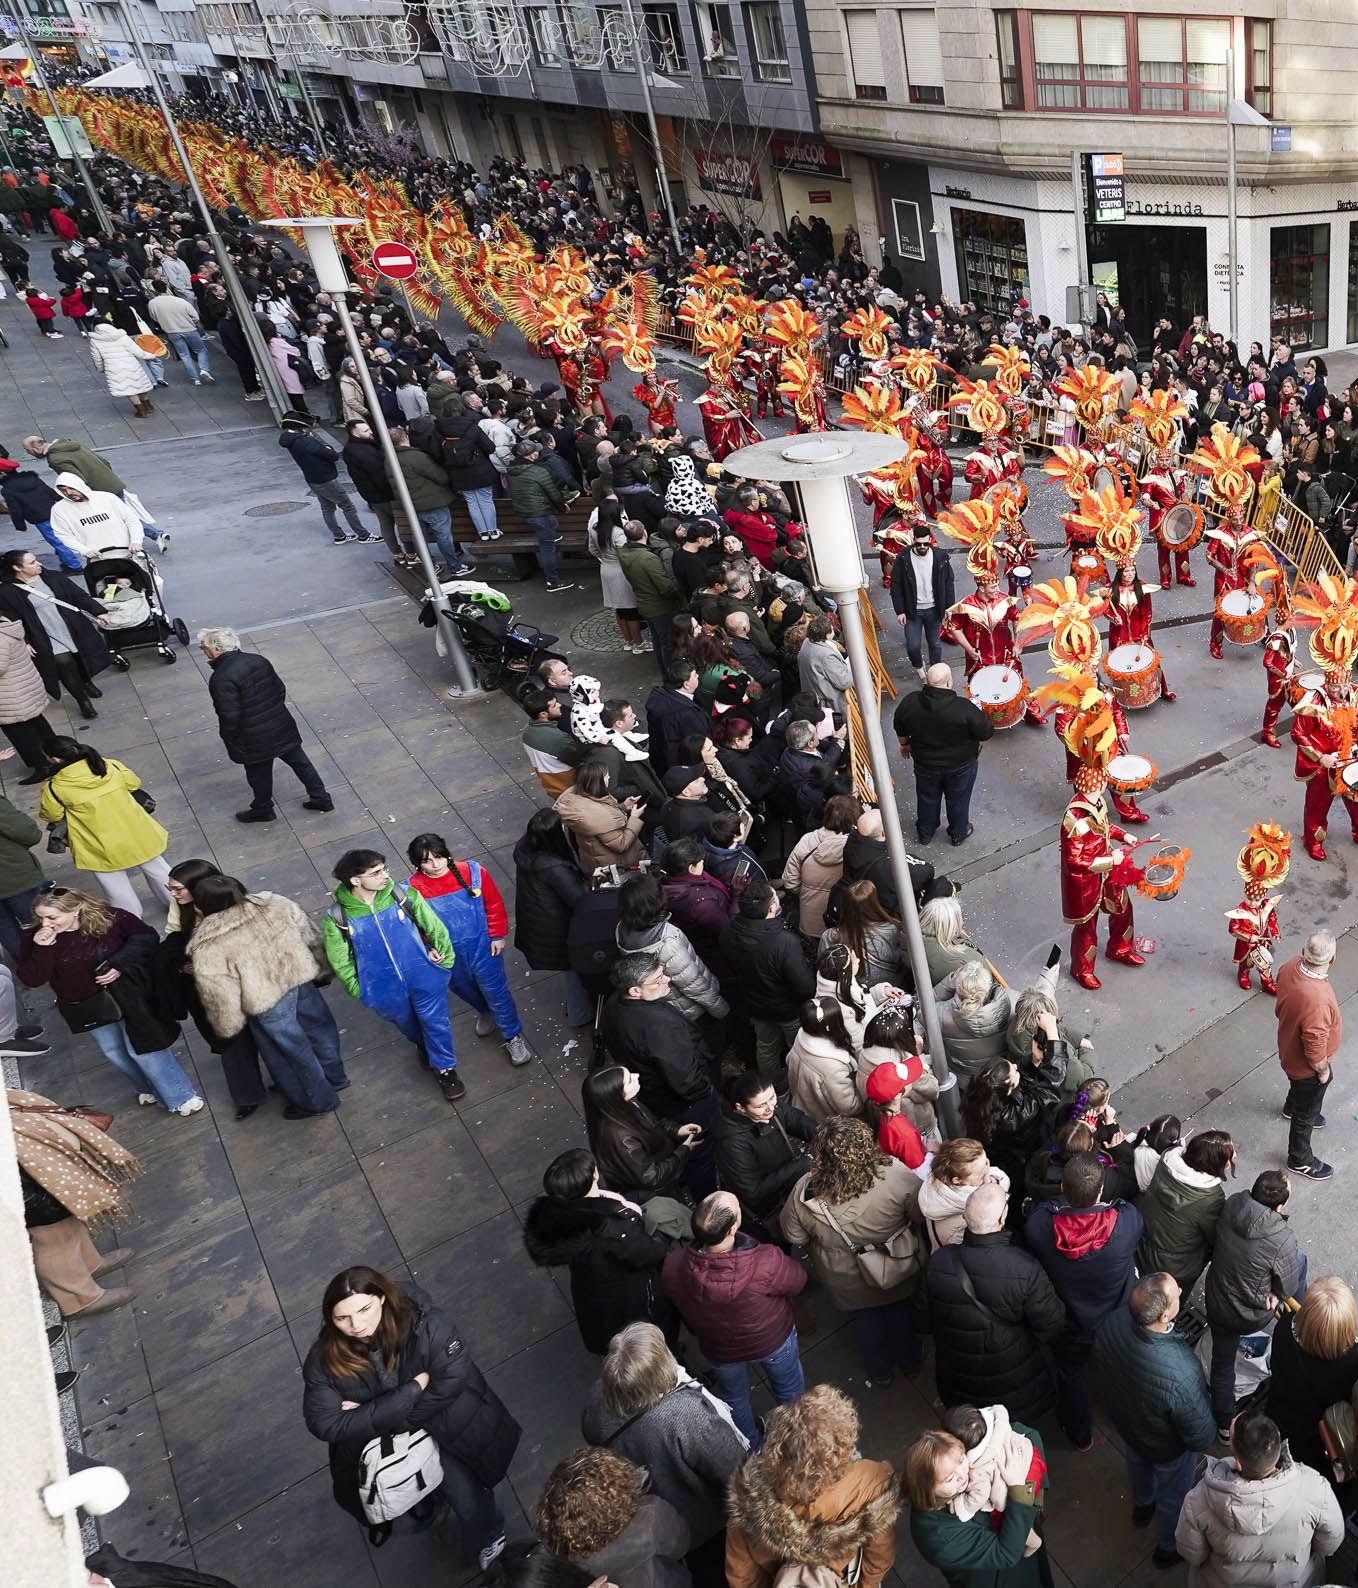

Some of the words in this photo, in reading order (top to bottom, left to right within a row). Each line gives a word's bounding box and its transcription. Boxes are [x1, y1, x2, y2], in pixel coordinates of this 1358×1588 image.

[784, 143, 827, 165] SUPERCOR
[1096, 188, 1123, 200] VETERIS
[1126, 200, 1204, 216] Florinda
[80, 512, 110, 526] PUMA
